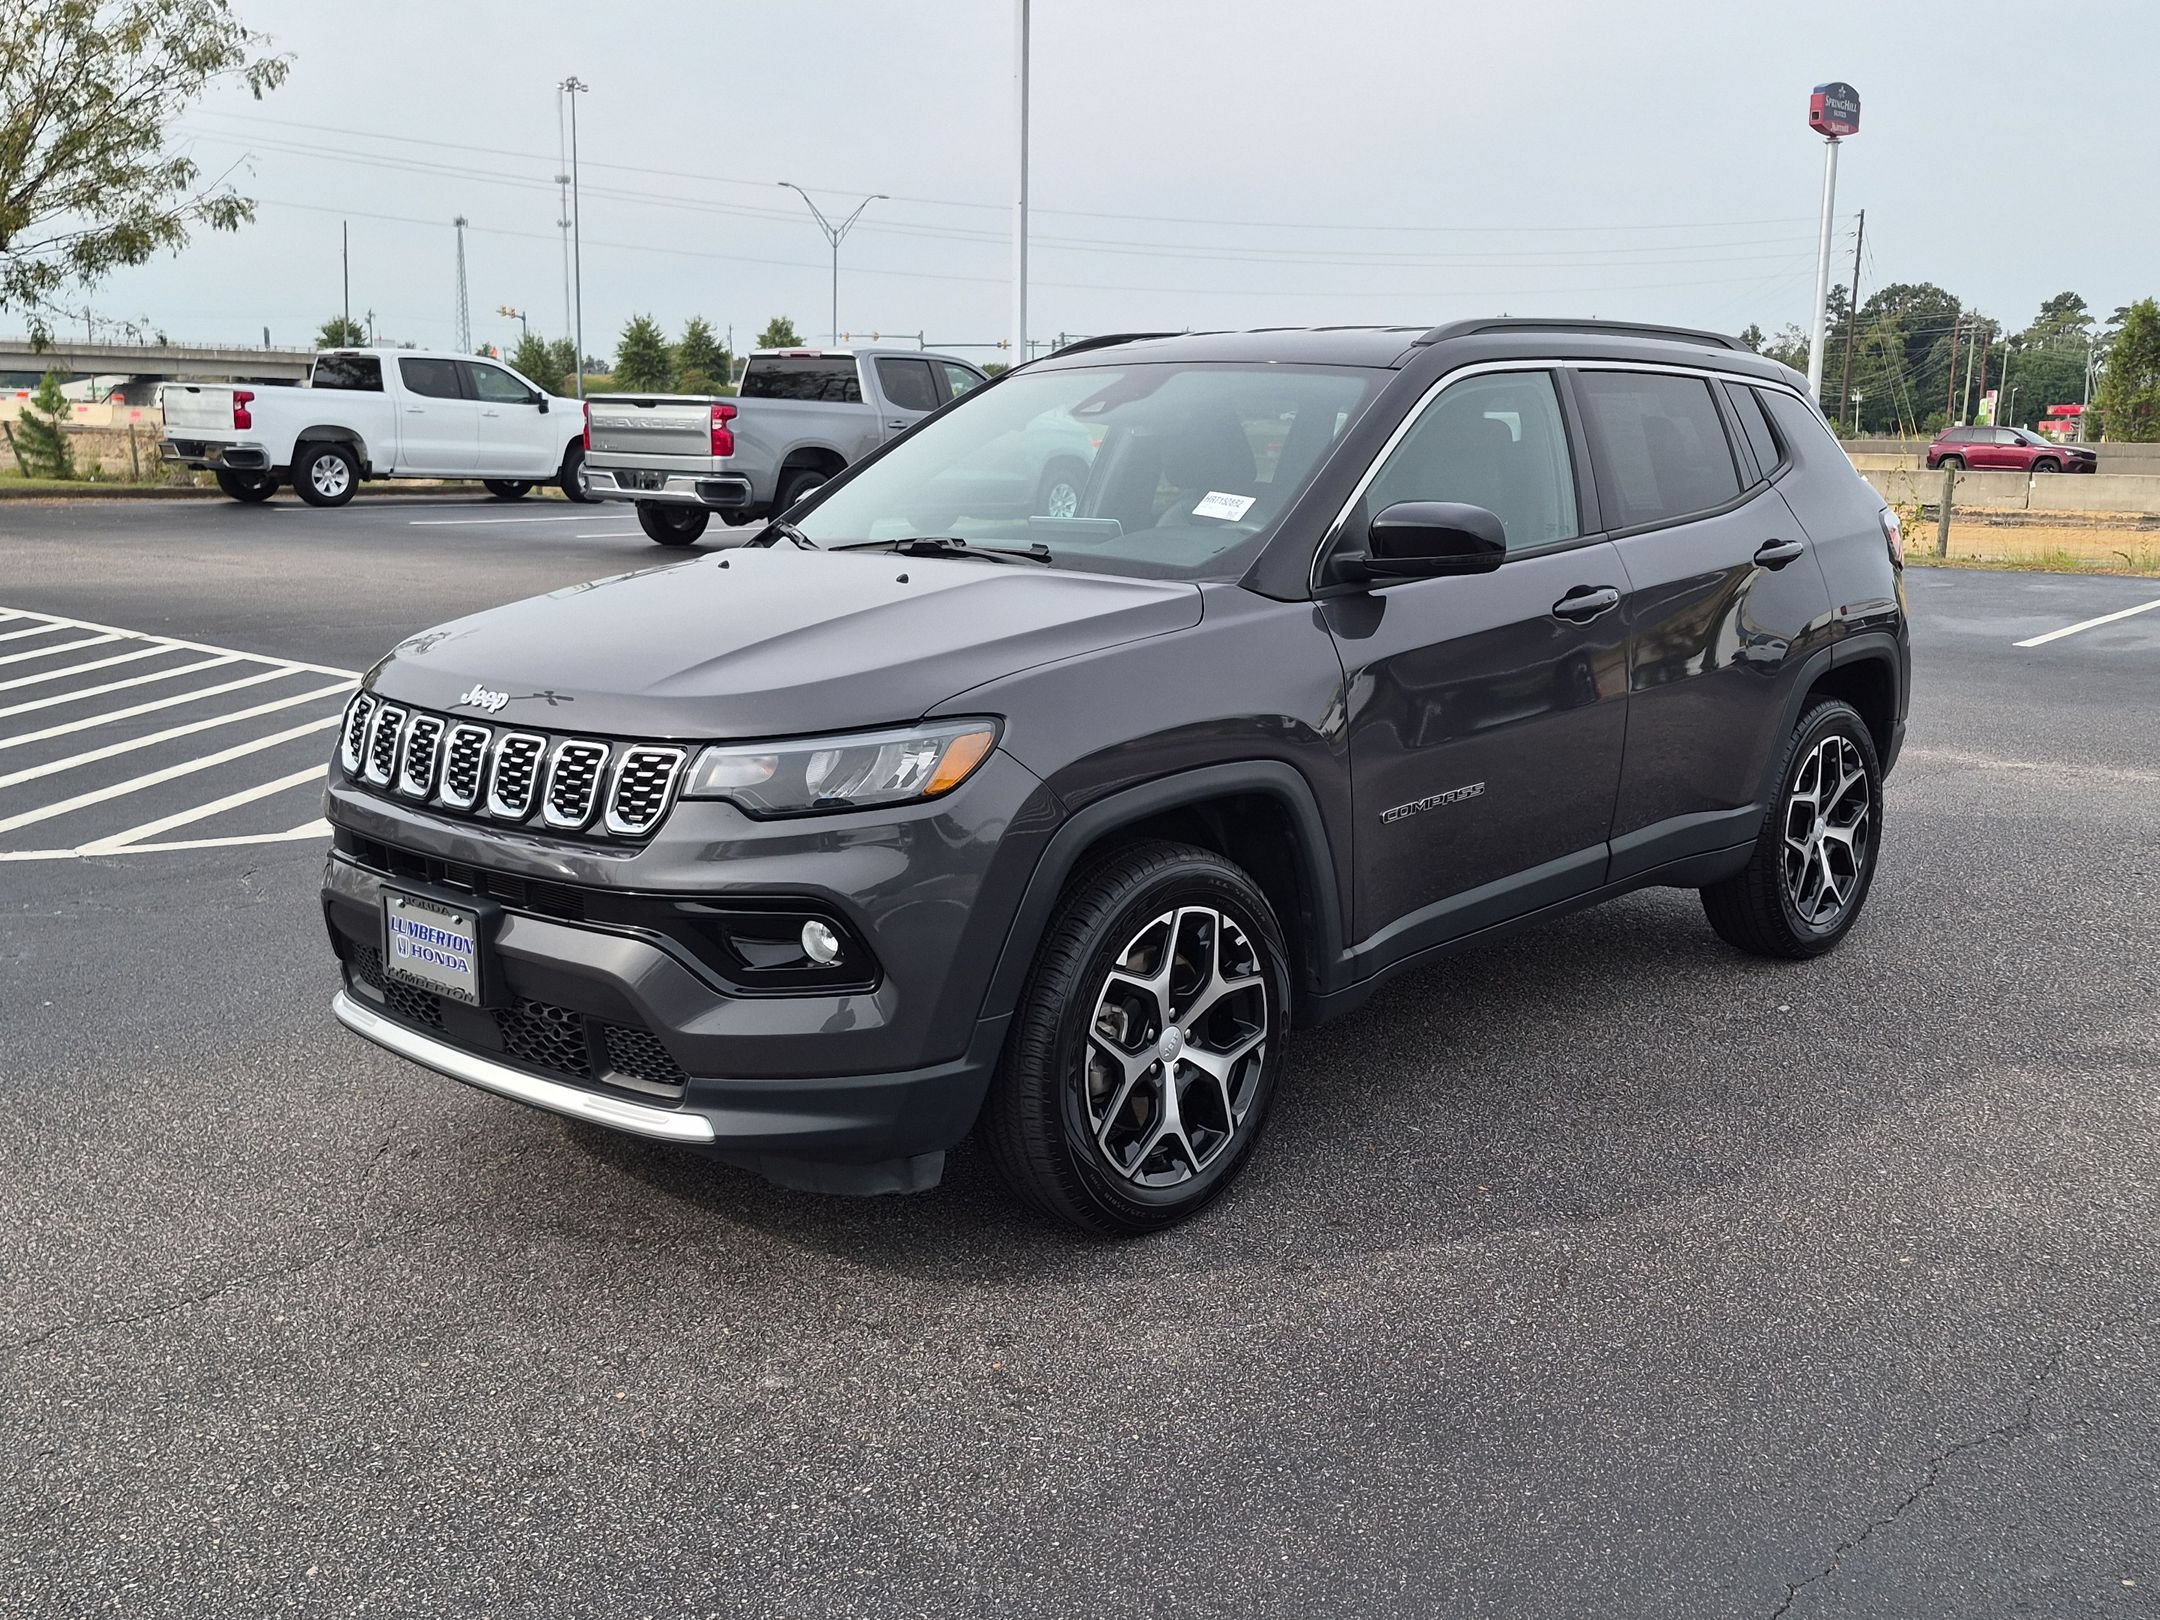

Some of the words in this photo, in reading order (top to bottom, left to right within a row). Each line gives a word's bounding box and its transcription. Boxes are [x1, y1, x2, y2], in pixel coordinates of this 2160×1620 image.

[593, 417, 700, 430] CHEVROLET
[460, 683, 510, 715] Jeep
[1381, 781, 1486, 824] COMPASS
[391, 914, 474, 955] LUMBERTON
[411, 942, 471, 975] HONDA
[388, 966, 474, 1003] LUMBERTON
